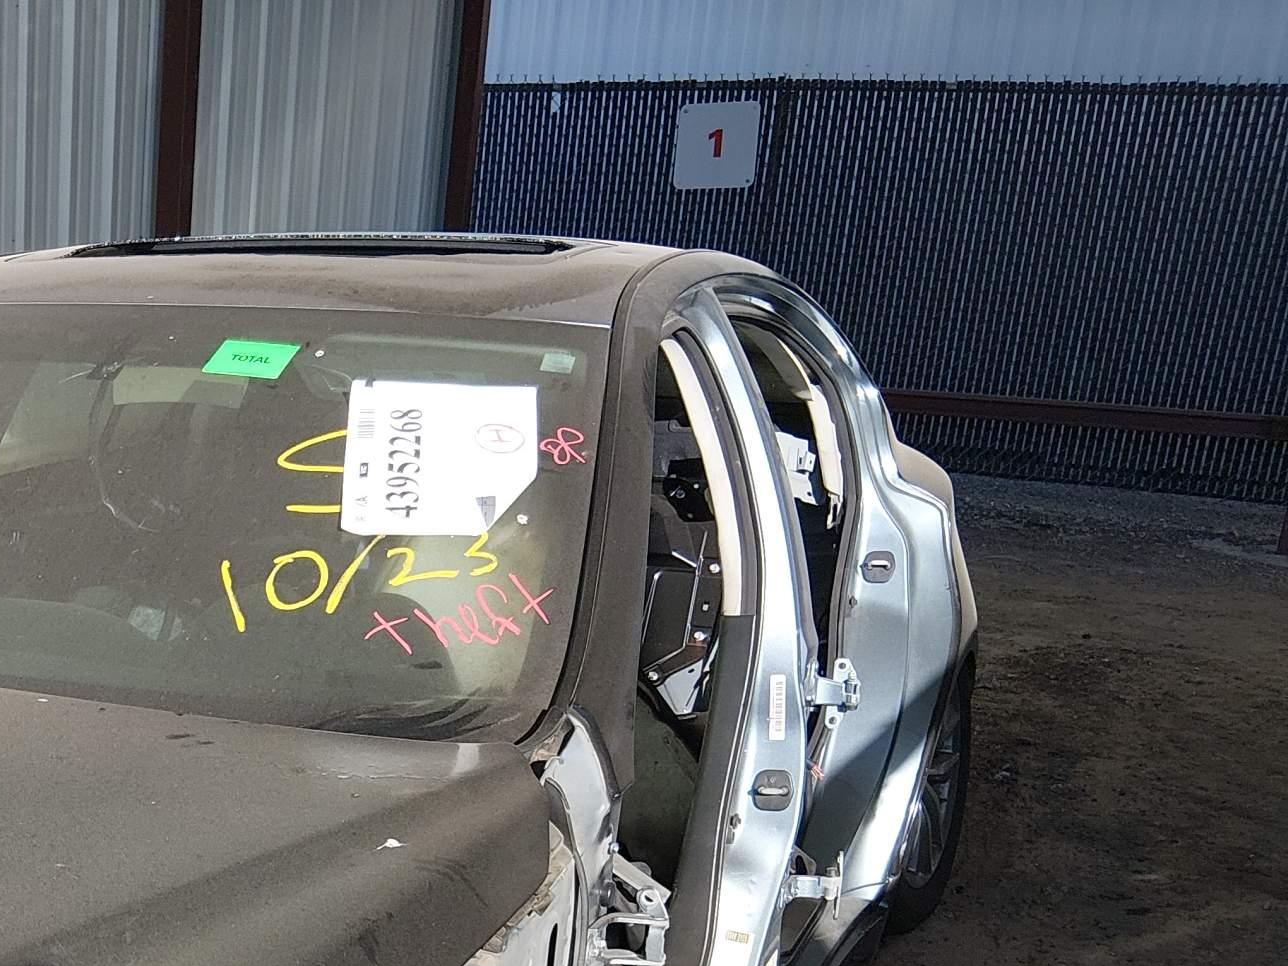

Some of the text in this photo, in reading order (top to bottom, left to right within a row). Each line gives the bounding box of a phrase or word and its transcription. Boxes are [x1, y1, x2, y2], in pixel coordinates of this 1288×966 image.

[707, 129, 723, 158] 1
[231, 353, 271, 364] TOTAL
[384, 408, 423, 518] 43952268
[220, 531, 499, 633] 10/23
[363, 572, 555, 655] theft
